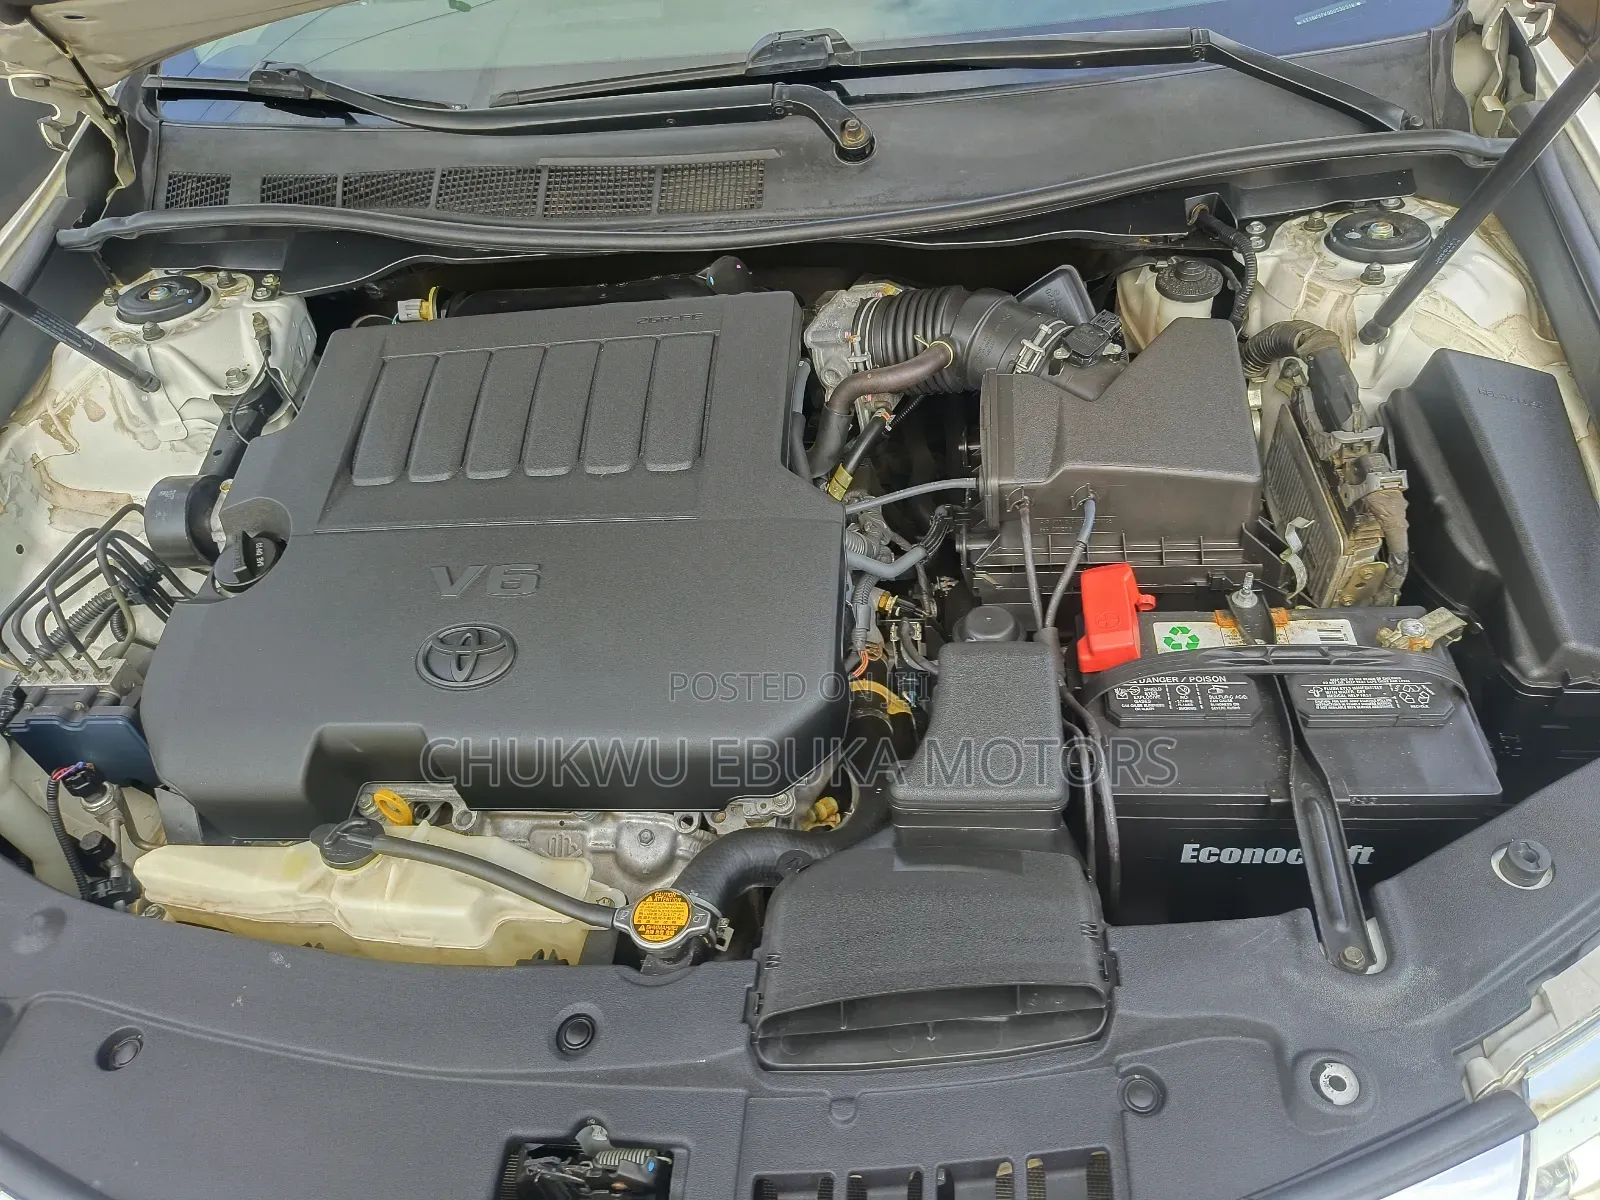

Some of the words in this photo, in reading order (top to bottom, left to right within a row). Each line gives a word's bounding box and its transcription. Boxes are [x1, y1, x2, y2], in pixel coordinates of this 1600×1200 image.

[430, 563, 541, 598] V6
[1189, 675, 1227, 683] POISON
[1180, 843, 1375, 865] Econocft
